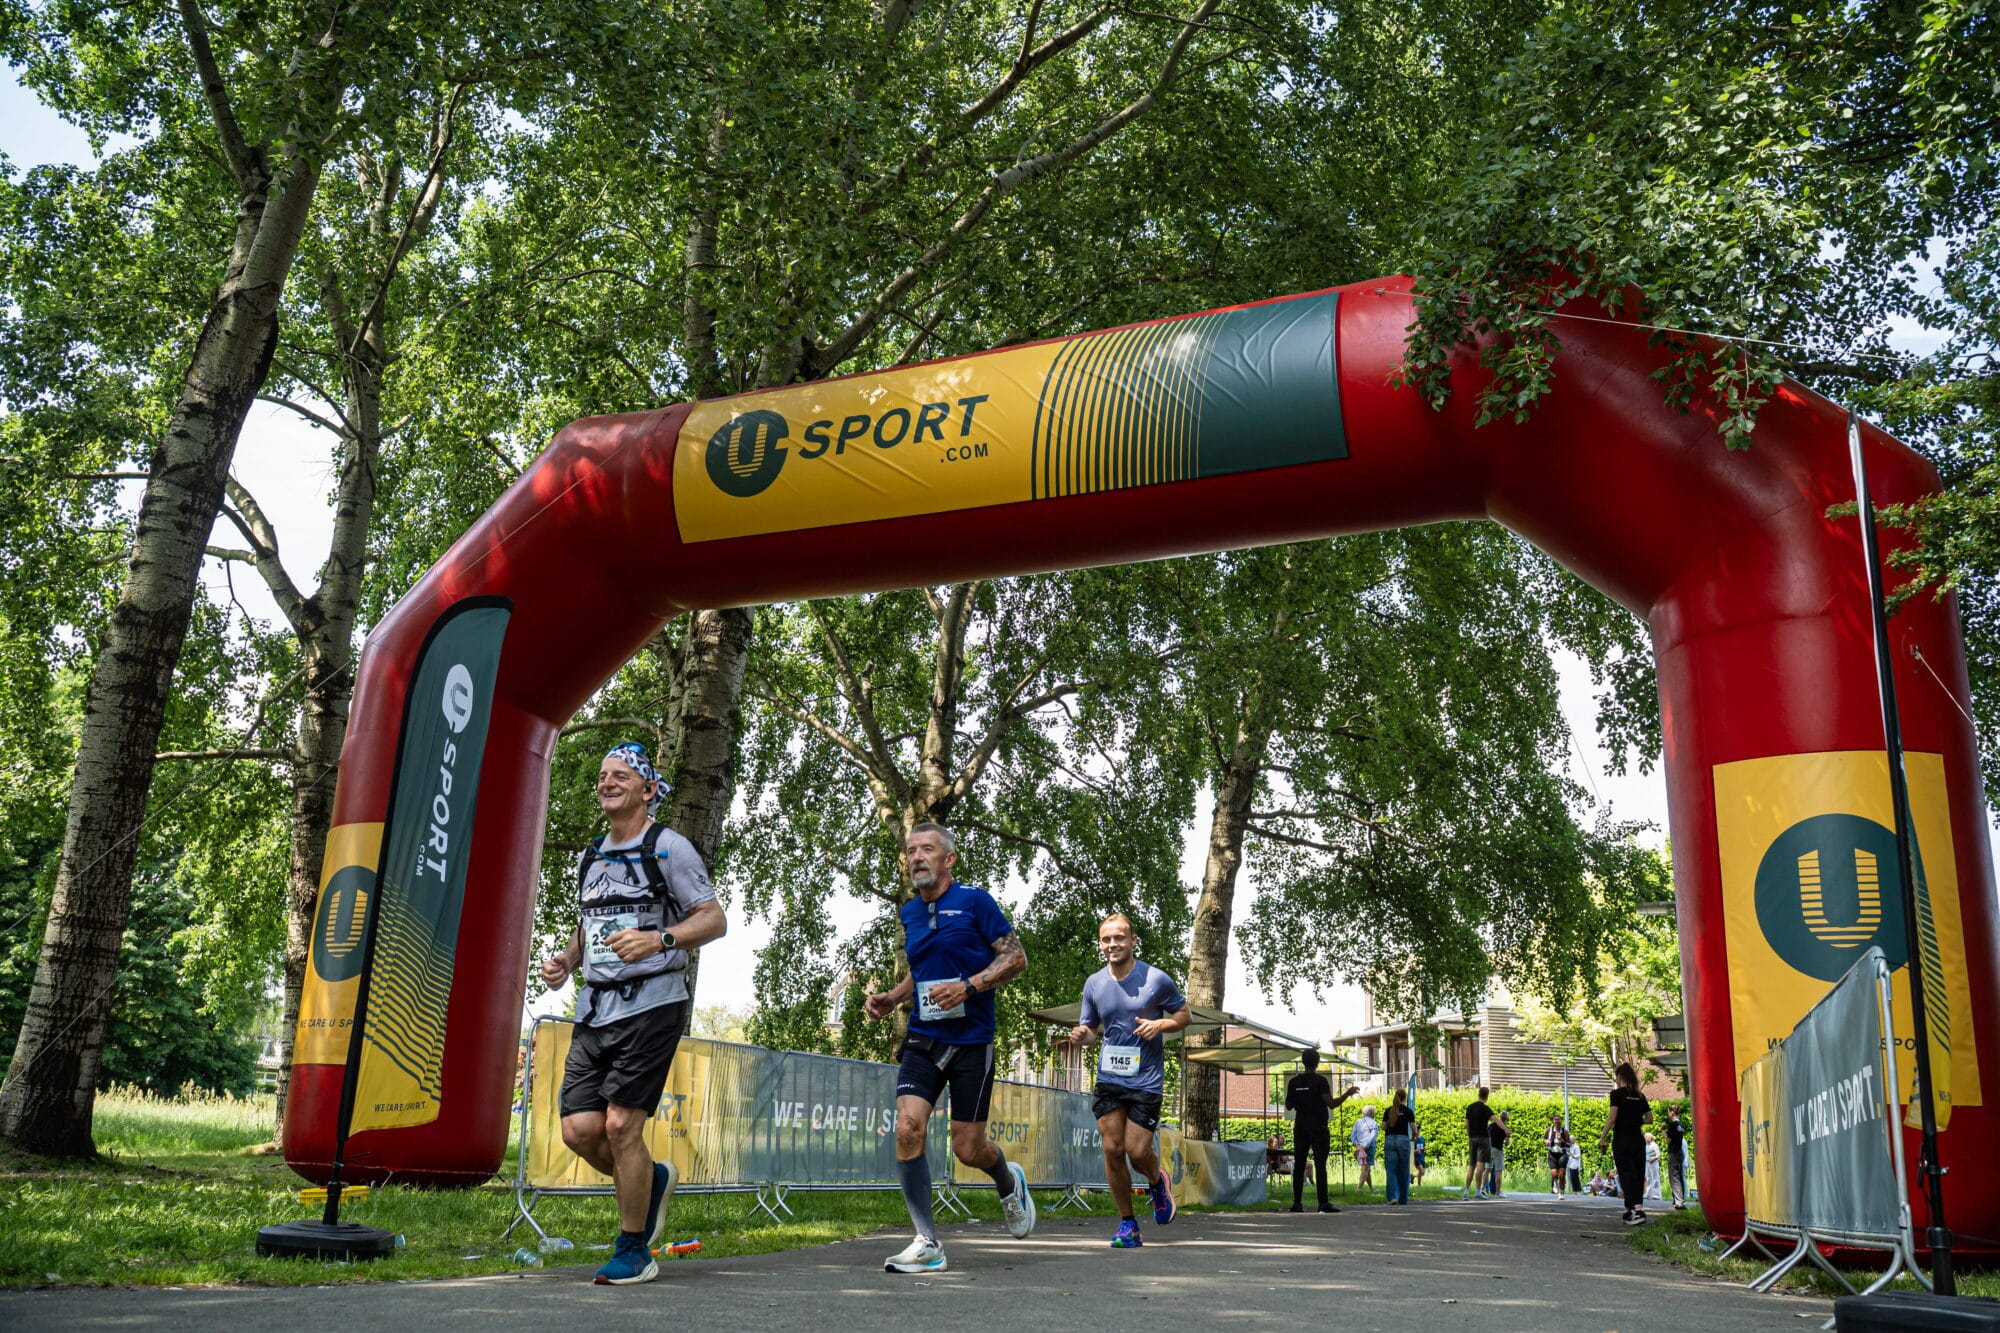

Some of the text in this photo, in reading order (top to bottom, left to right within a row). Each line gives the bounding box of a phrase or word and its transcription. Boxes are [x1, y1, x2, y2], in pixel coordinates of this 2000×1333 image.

[798, 394, 990, 459] SPORT
[940, 442, 989, 463] .COM
[426, 736, 457, 883] SPORT
[415, 839, 426, 876] .COM
[593, 905, 635, 917] LEGEND
[638, 904, 654, 913] OF
[308, 1018, 327, 1028] CARE
[329, 1018, 336, 1028] U
[1110, 1056, 1132, 1066] 1145
[374, 1103, 385, 1112] WE
[386, 1103, 404, 1112] CARE
[774, 1100, 804, 1128] WE
[812, 1103, 858, 1131] CARE
[866, 1107, 876, 1132] U
[1807, 1090, 1830, 1141] CARE
[1829, 1086, 1838, 1134] U
[989, 1120, 1029, 1144] SPORT
[1073, 1127, 1103, 1148] WE CA
